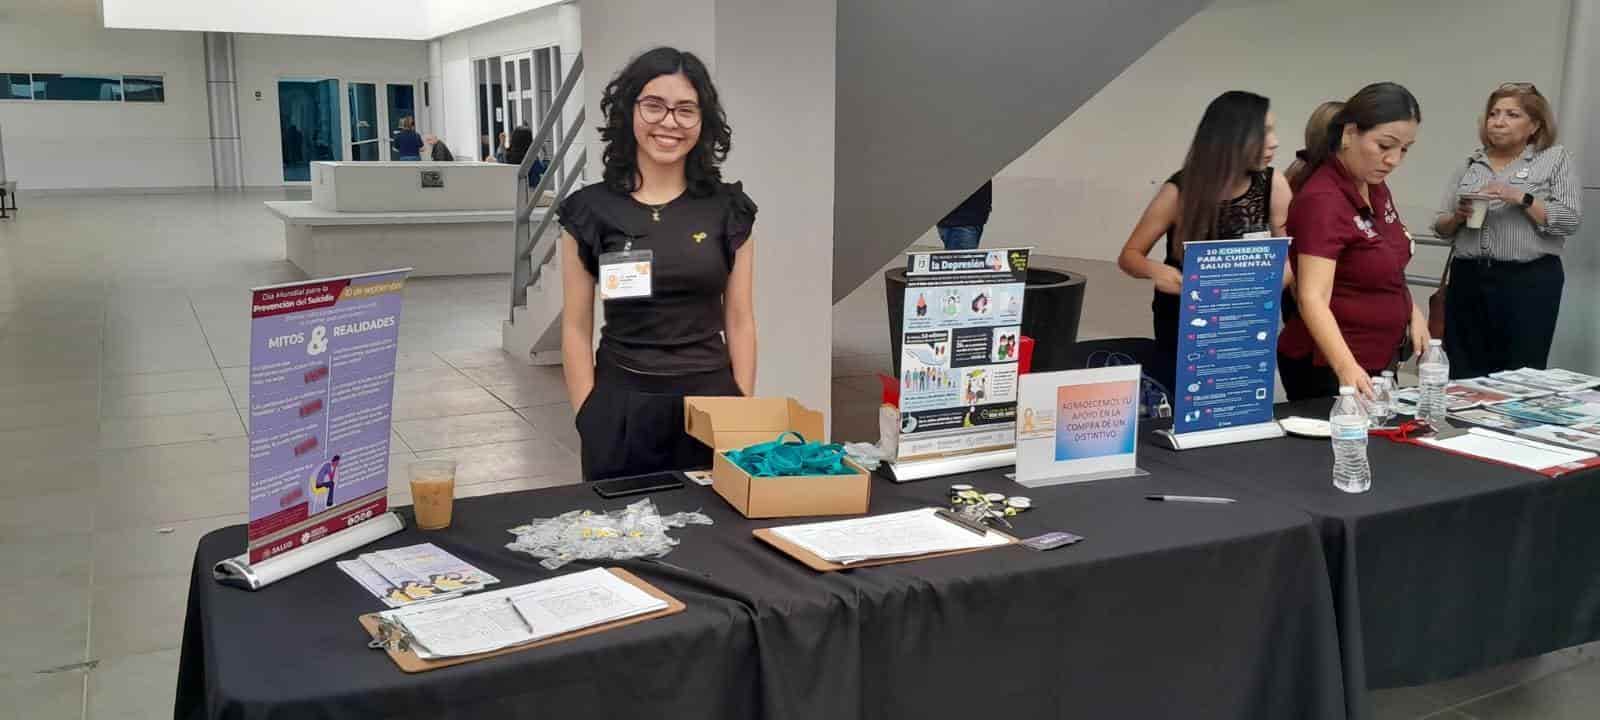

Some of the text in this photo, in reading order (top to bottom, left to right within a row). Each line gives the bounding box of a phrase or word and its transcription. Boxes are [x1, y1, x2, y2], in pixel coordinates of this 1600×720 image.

[1206, 248, 1217, 256] 10
[931, 258, 985, 271] la Depresión
[1197, 255, 1223, 263] PARA
[1225, 254, 1261, 262] CUIDAR
[1200, 260, 1272, 270] SALUD MENTAL
[276, 288, 305, 299] Mundial
[253, 294, 334, 313] Prevención del Suicidio
[268, 332, 305, 349] MITOS
[307, 325, 328, 355] &
[333, 315, 395, 337] REALIDADES
[1063, 398, 1121, 410] AGRADECEMOS
[1072, 408, 1121, 420] APOYO EN LA
[1066, 421, 1100, 432] COMPRA
[1074, 430, 1117, 442] DISTINTIVO
